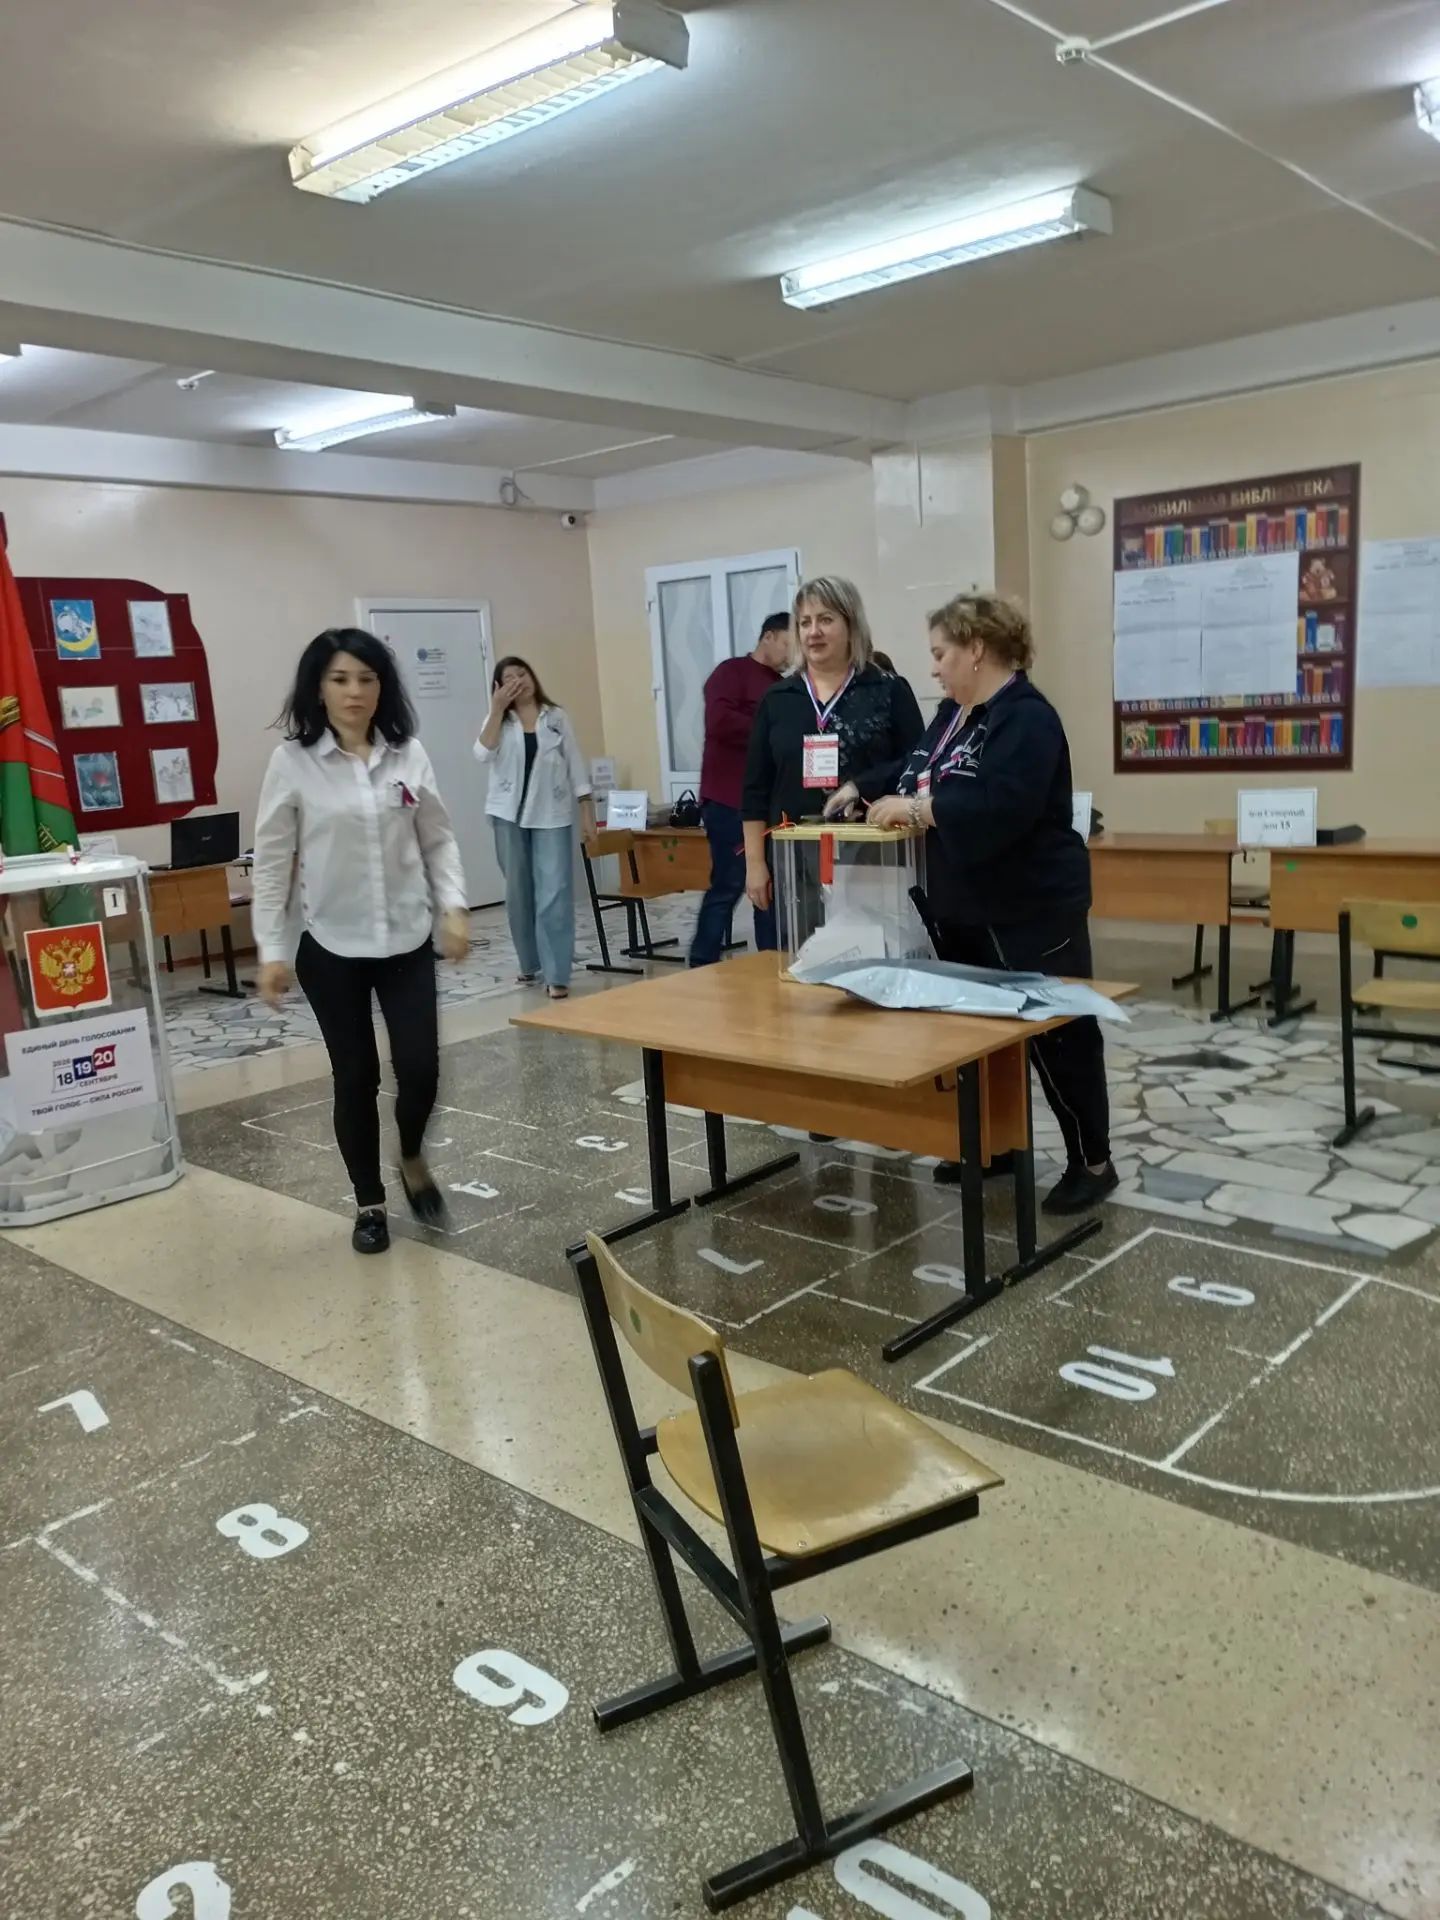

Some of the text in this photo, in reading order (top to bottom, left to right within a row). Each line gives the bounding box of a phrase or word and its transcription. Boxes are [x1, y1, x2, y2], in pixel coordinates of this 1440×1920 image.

[1230, 479, 1335, 506] БИБЛИОТЕКА
[111, 893, 119, 907] 1
[22, 1026, 136, 1054] ЕДИНЫЙ ДЕНЬ ГОЛОСОВАНИЯ
[75, 1061, 92, 1076] 19
[94, 1051, 113, 1066] 20
[57, 1072, 74, 1086] 18
[79, 1073, 118, 1087] СЕНТЯБРЯ
[32, 1105, 54, 1116] ТВОЙ
[55, 1100, 81, 1111] ГОЛОС
[90, 1094, 110, 1104] СИЛА
[1058, 1344, 1176, 1401] 10
[38, 1389, 109, 1432] 7
[215, 1503, 309, 1559] 8
[452, 1648, 569, 1725] 9
